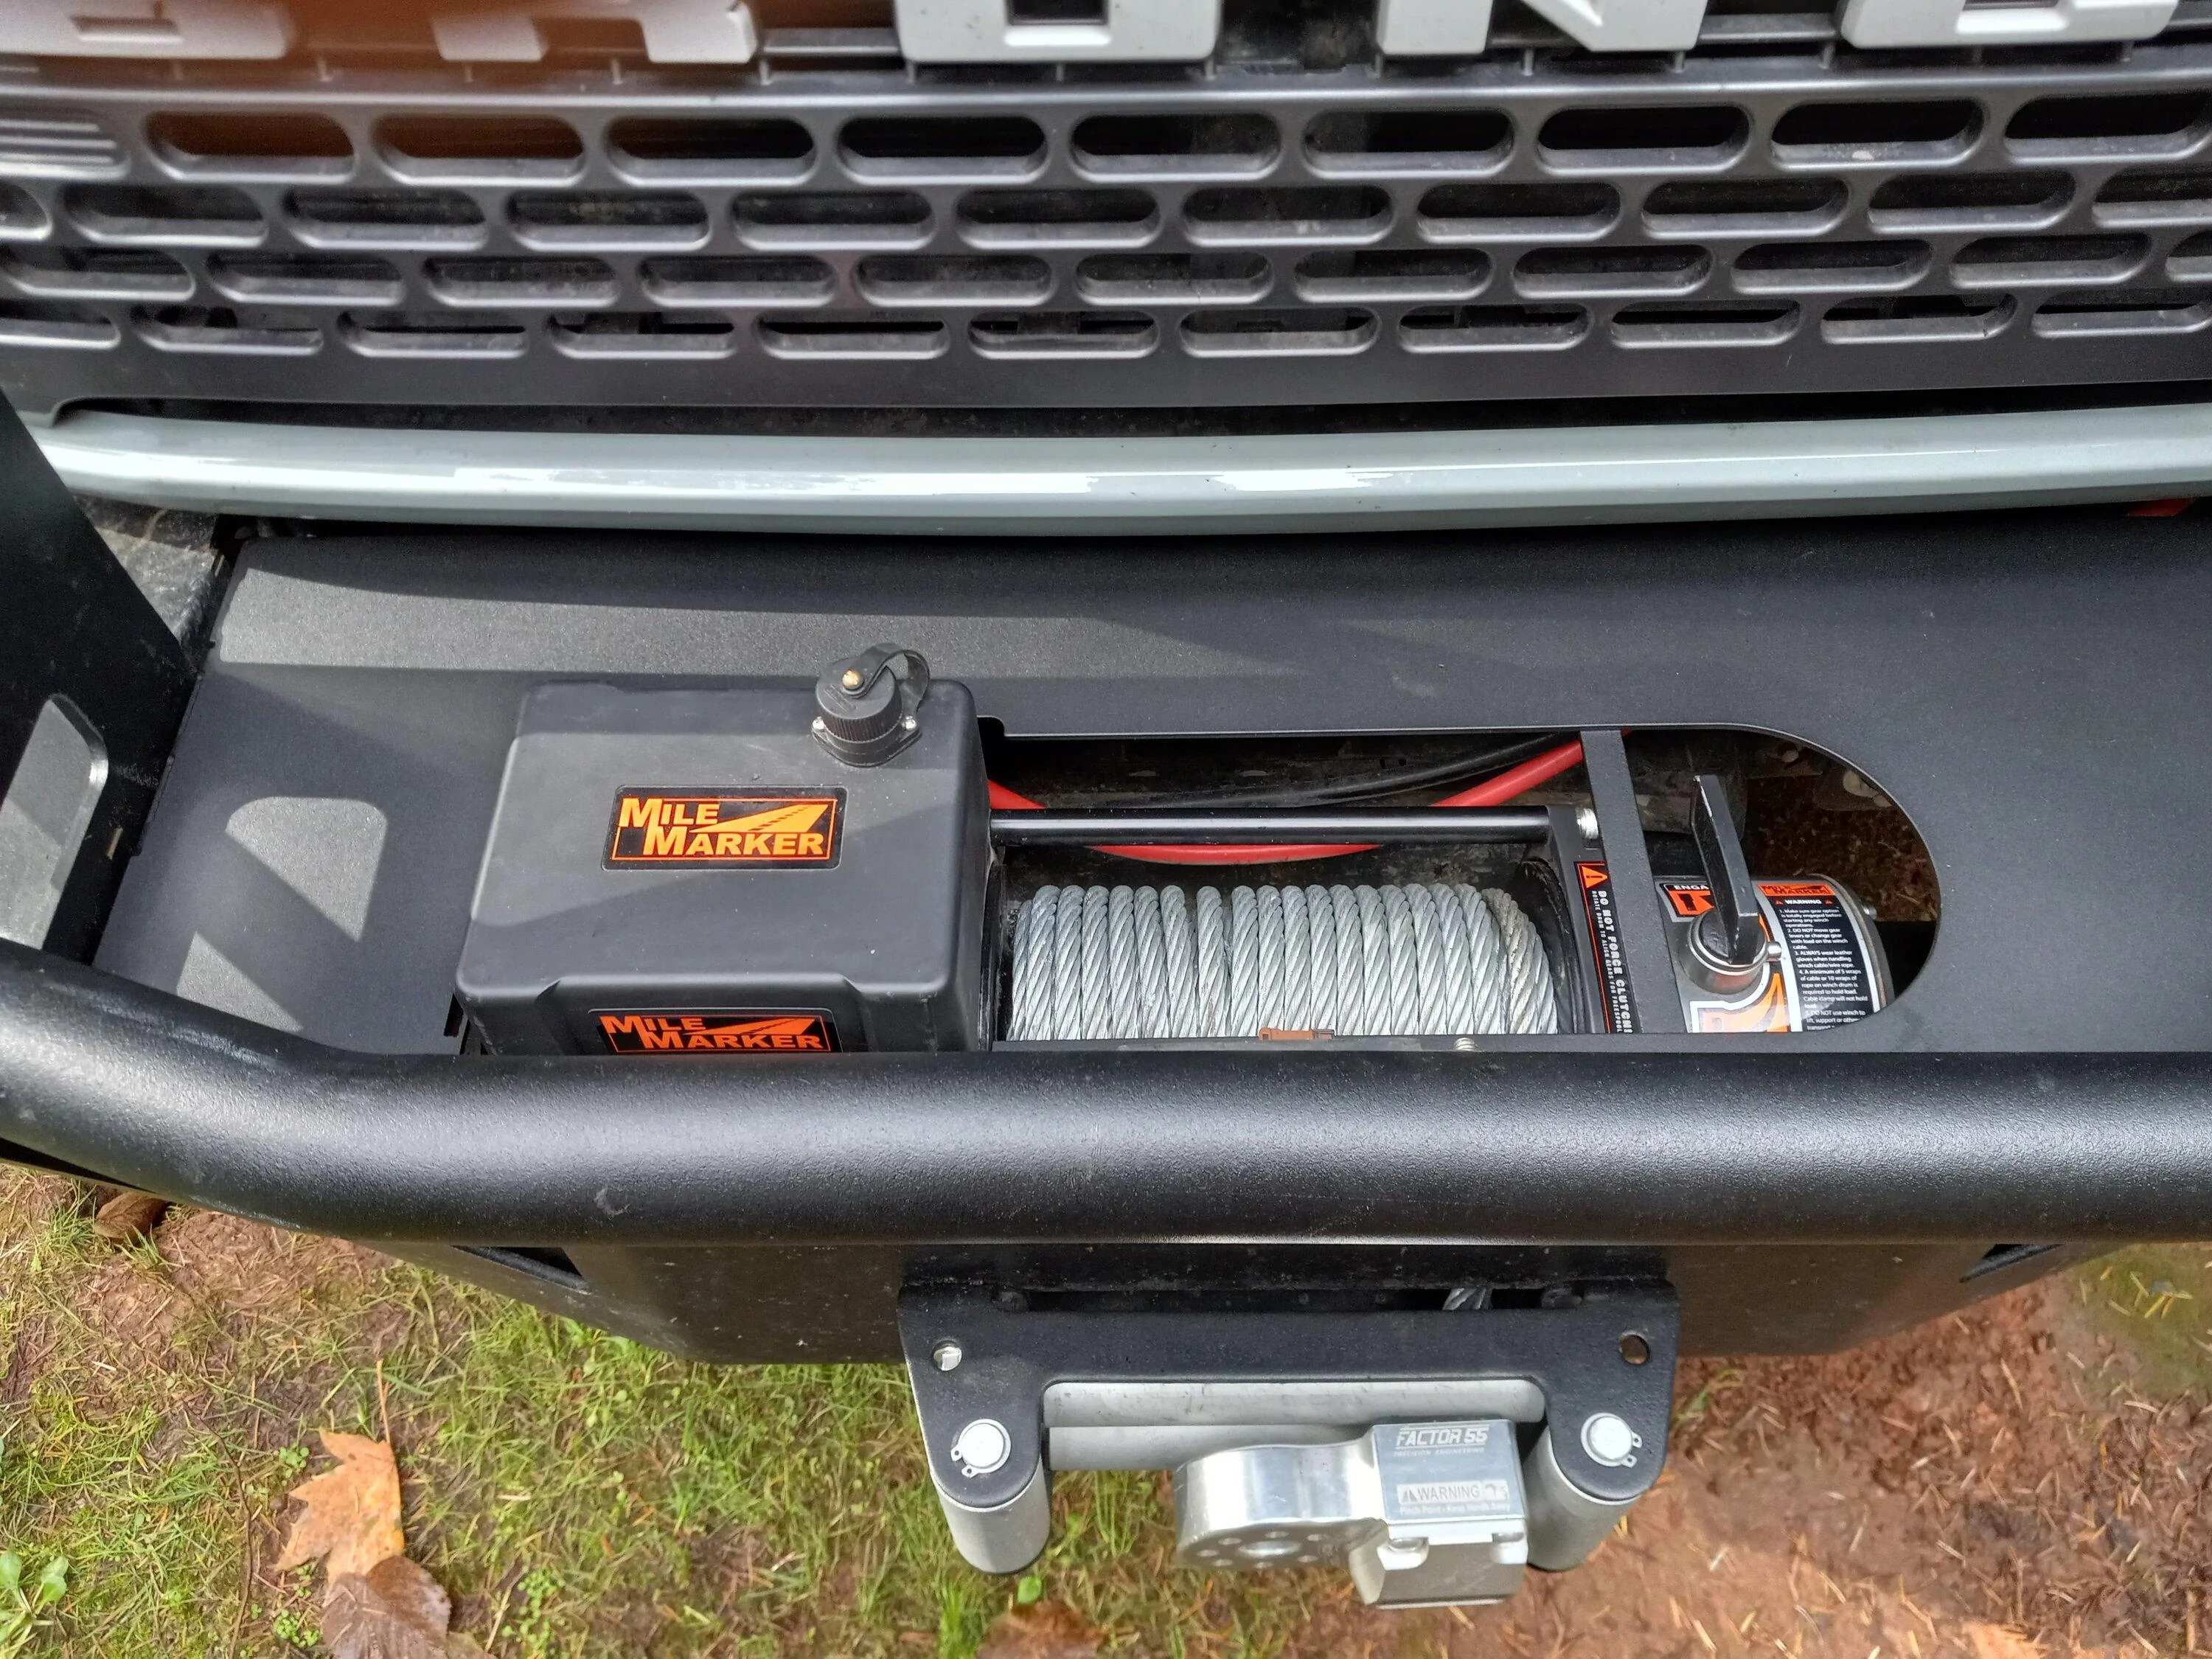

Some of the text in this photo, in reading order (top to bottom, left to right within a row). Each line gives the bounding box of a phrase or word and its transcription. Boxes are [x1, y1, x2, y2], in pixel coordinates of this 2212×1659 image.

[619, 798, 720, 827] MILE
[642, 825, 824, 856] MARKER
[1592, 891, 1600, 910] ROTATE
[1596, 913, 1604, 928] DRUM
[1601, 940, 1610, 957] ALIGN
[1598, 891, 1632, 1032] DO NOT FORCE CLUTCH!
[1605, 959, 1614, 979] GEARS
[599, 1015, 706, 1033] MILE
[639, 1031, 824, 1048] MARKER
[1396, 1427, 1488, 1446] FACTOR 55
[1435, 1447, 1485, 1455] ENGINEERING
[1416, 1485, 1479, 1500] WARNING
